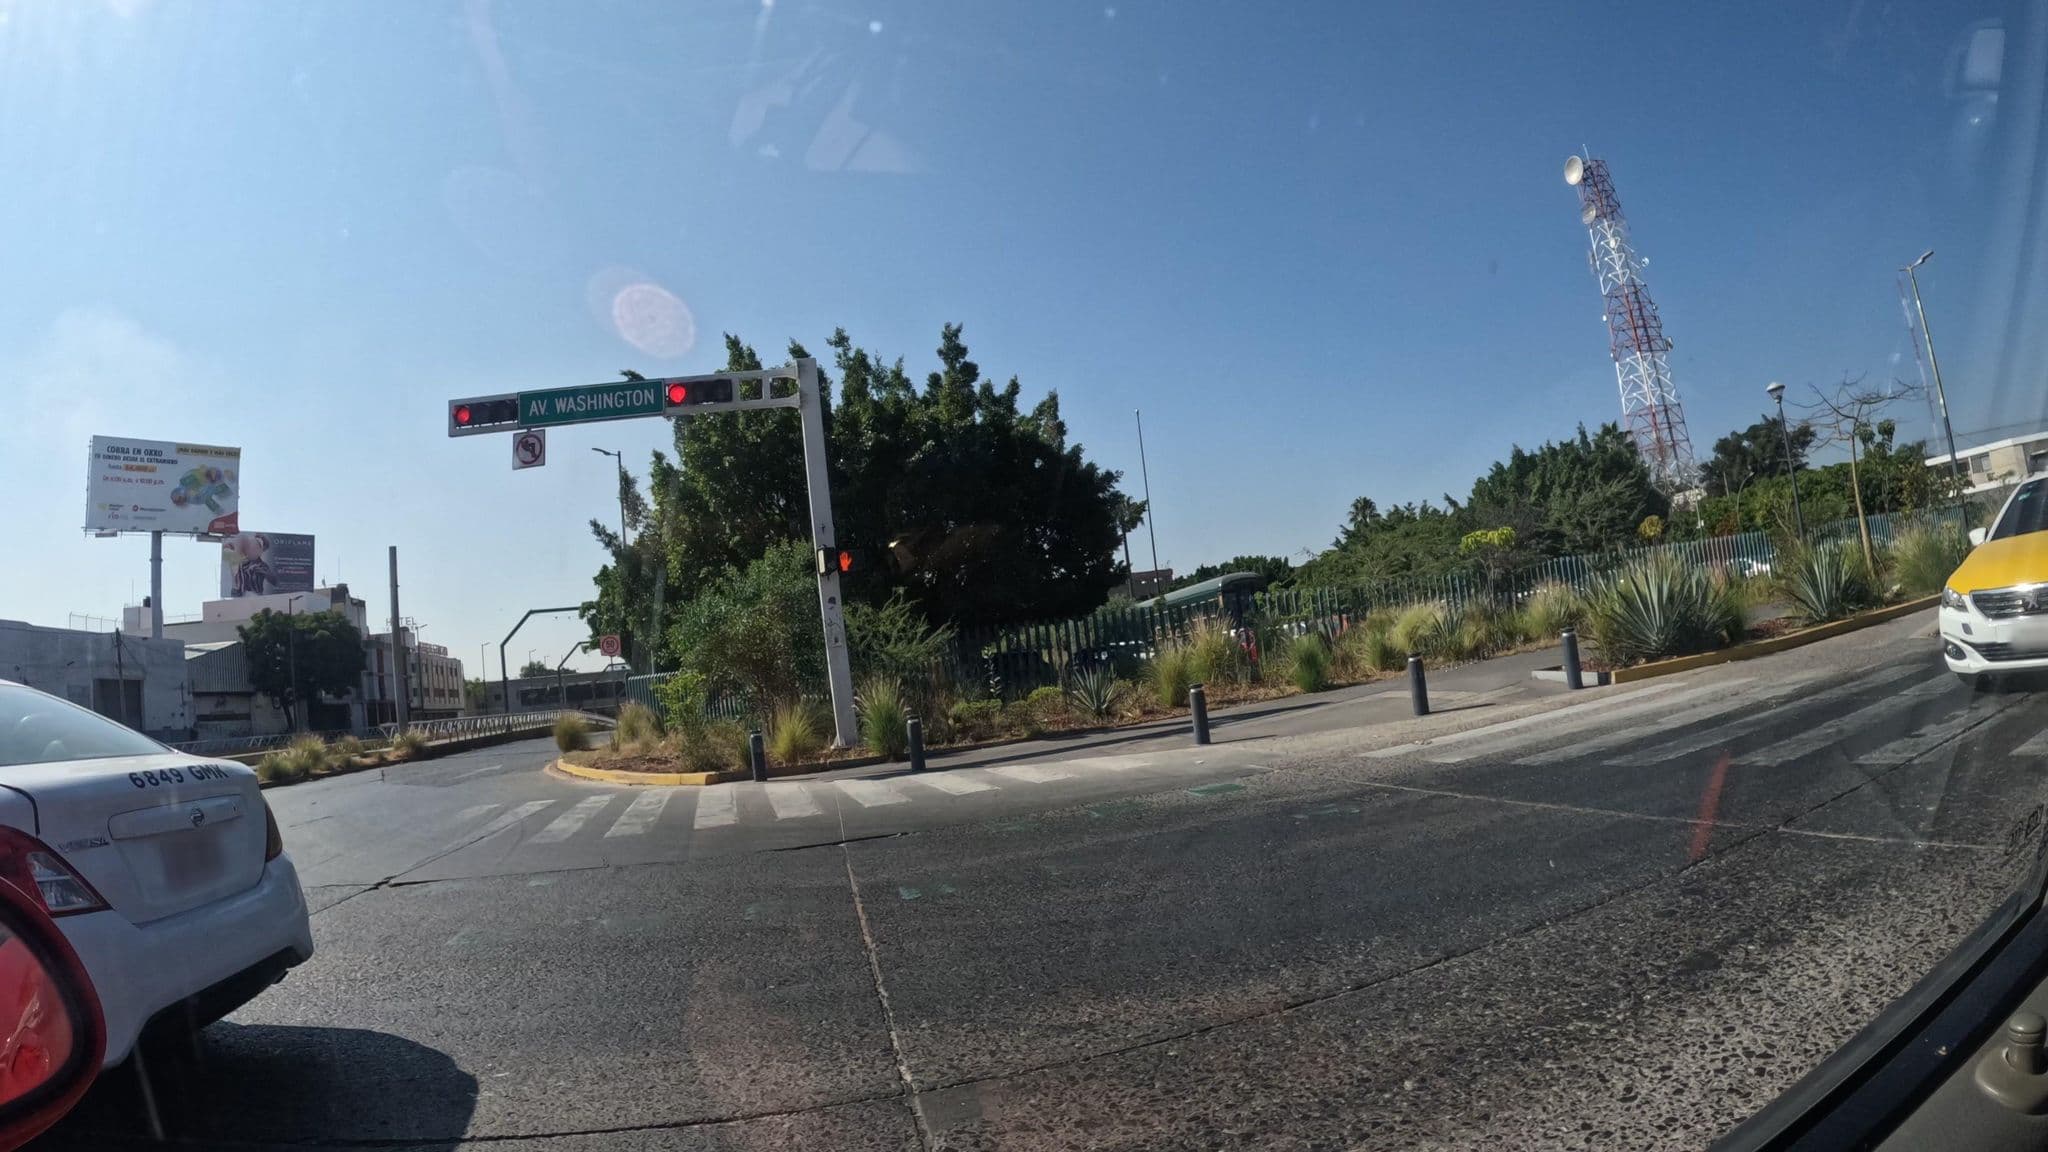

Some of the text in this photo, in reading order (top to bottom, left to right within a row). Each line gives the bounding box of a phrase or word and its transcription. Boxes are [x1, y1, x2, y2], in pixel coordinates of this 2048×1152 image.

[529, 389, 655, 417] AV. WASHINGTON
[106, 445, 163, 457] COBRA EN OXXO
[386, 616, 417, 626] HTEL
[128, 764, 229, 789] 6849 GMK
